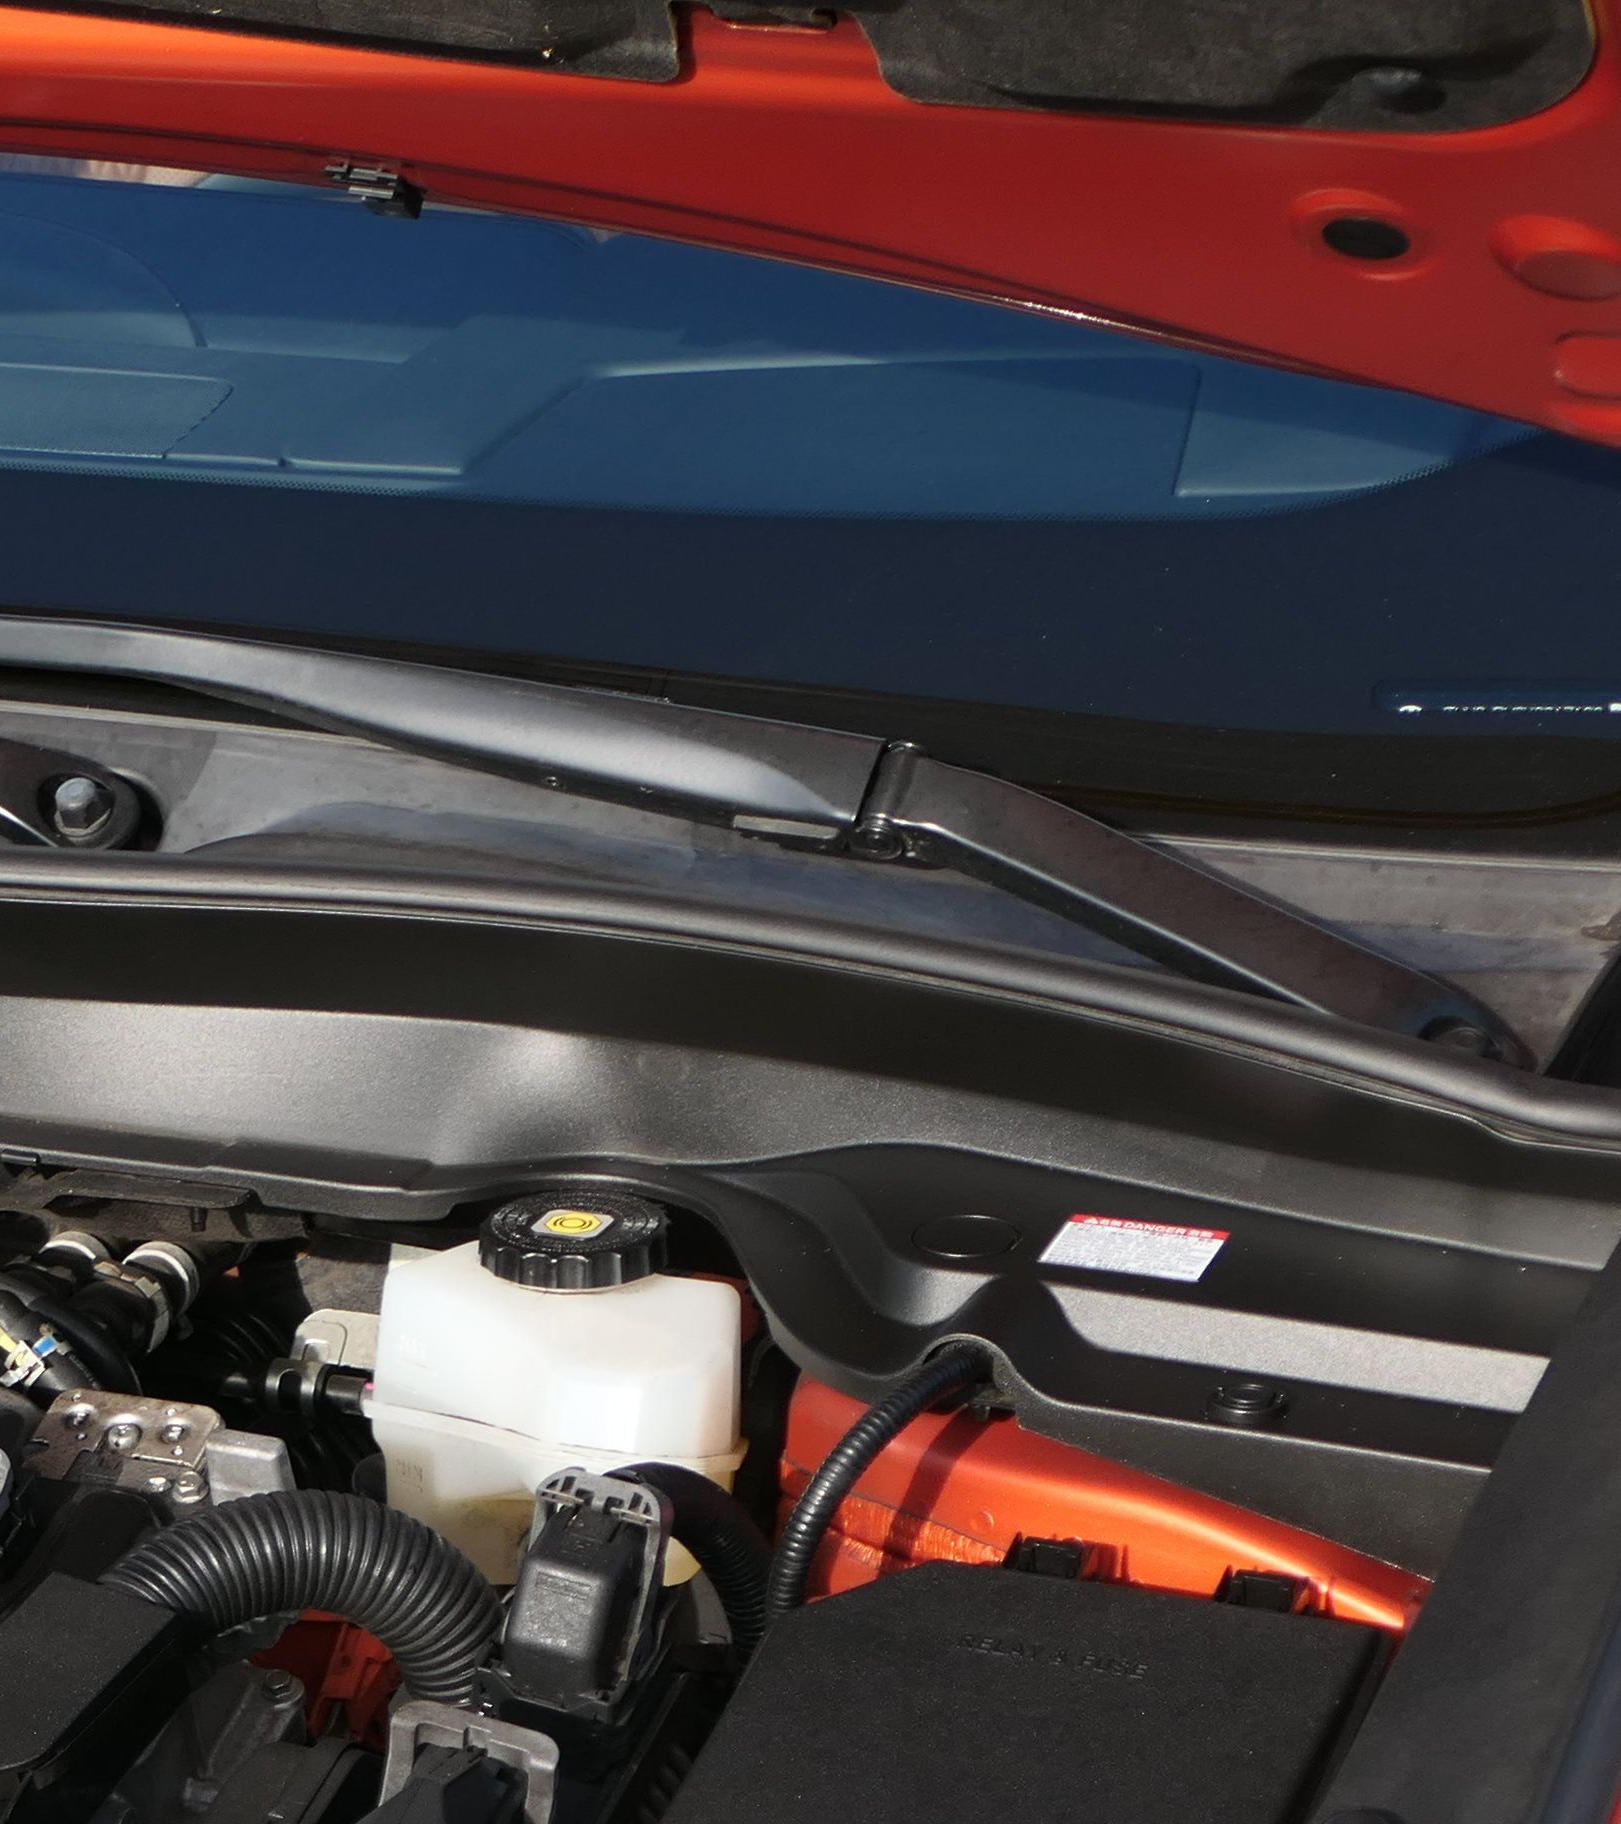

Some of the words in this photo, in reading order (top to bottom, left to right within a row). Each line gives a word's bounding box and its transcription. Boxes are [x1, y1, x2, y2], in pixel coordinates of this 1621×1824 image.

[1123, 1220, 1187, 1236] DANGER
[955, 1633, 1044, 1661] RELAY
[1082, 1651, 1149, 1680] FUSE
